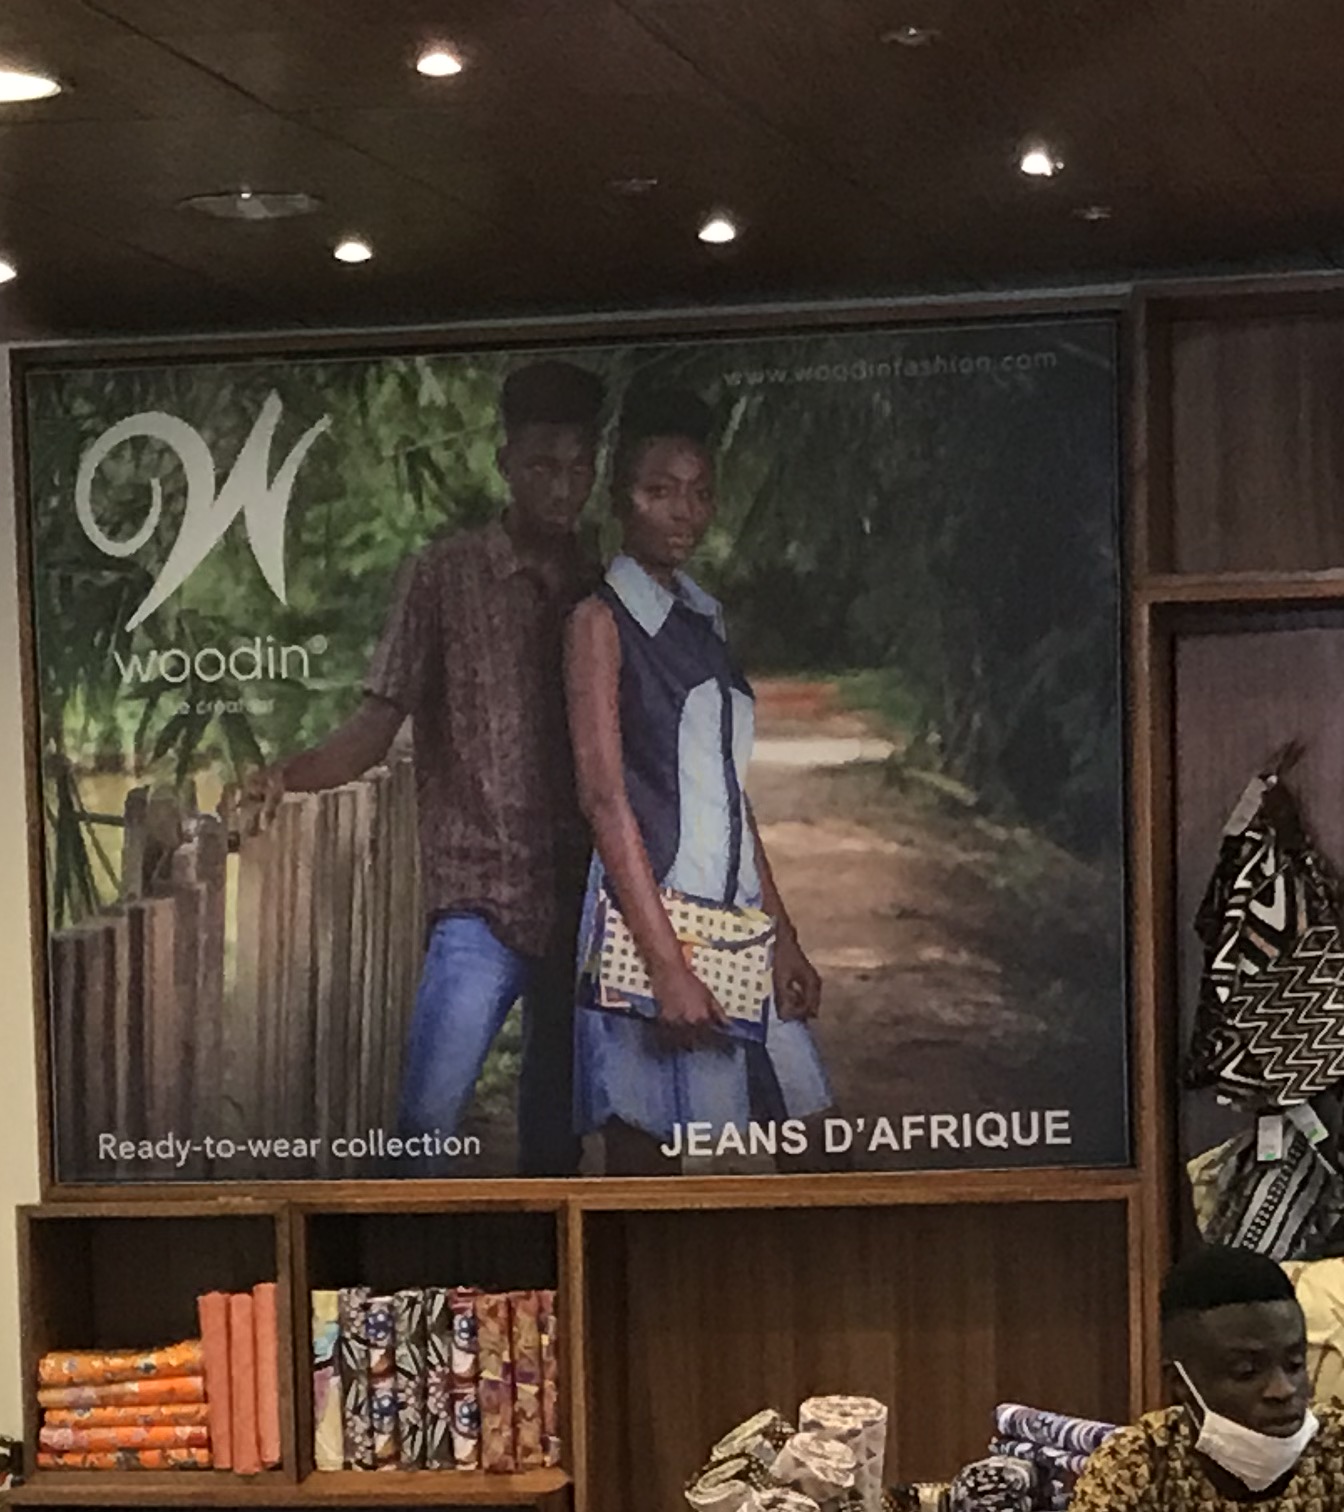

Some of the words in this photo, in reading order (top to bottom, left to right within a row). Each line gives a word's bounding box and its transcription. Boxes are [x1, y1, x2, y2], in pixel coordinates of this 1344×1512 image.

[723, 351, 1056, 386] www.woodinfashion.com
[97, 1132, 321, 1168] Ready-to-wear
[331, 1128, 481, 1158] collection
[660, 1119, 808, 1158] JEANS
[824, 1109, 1072, 1154] D'AFRIQUE
